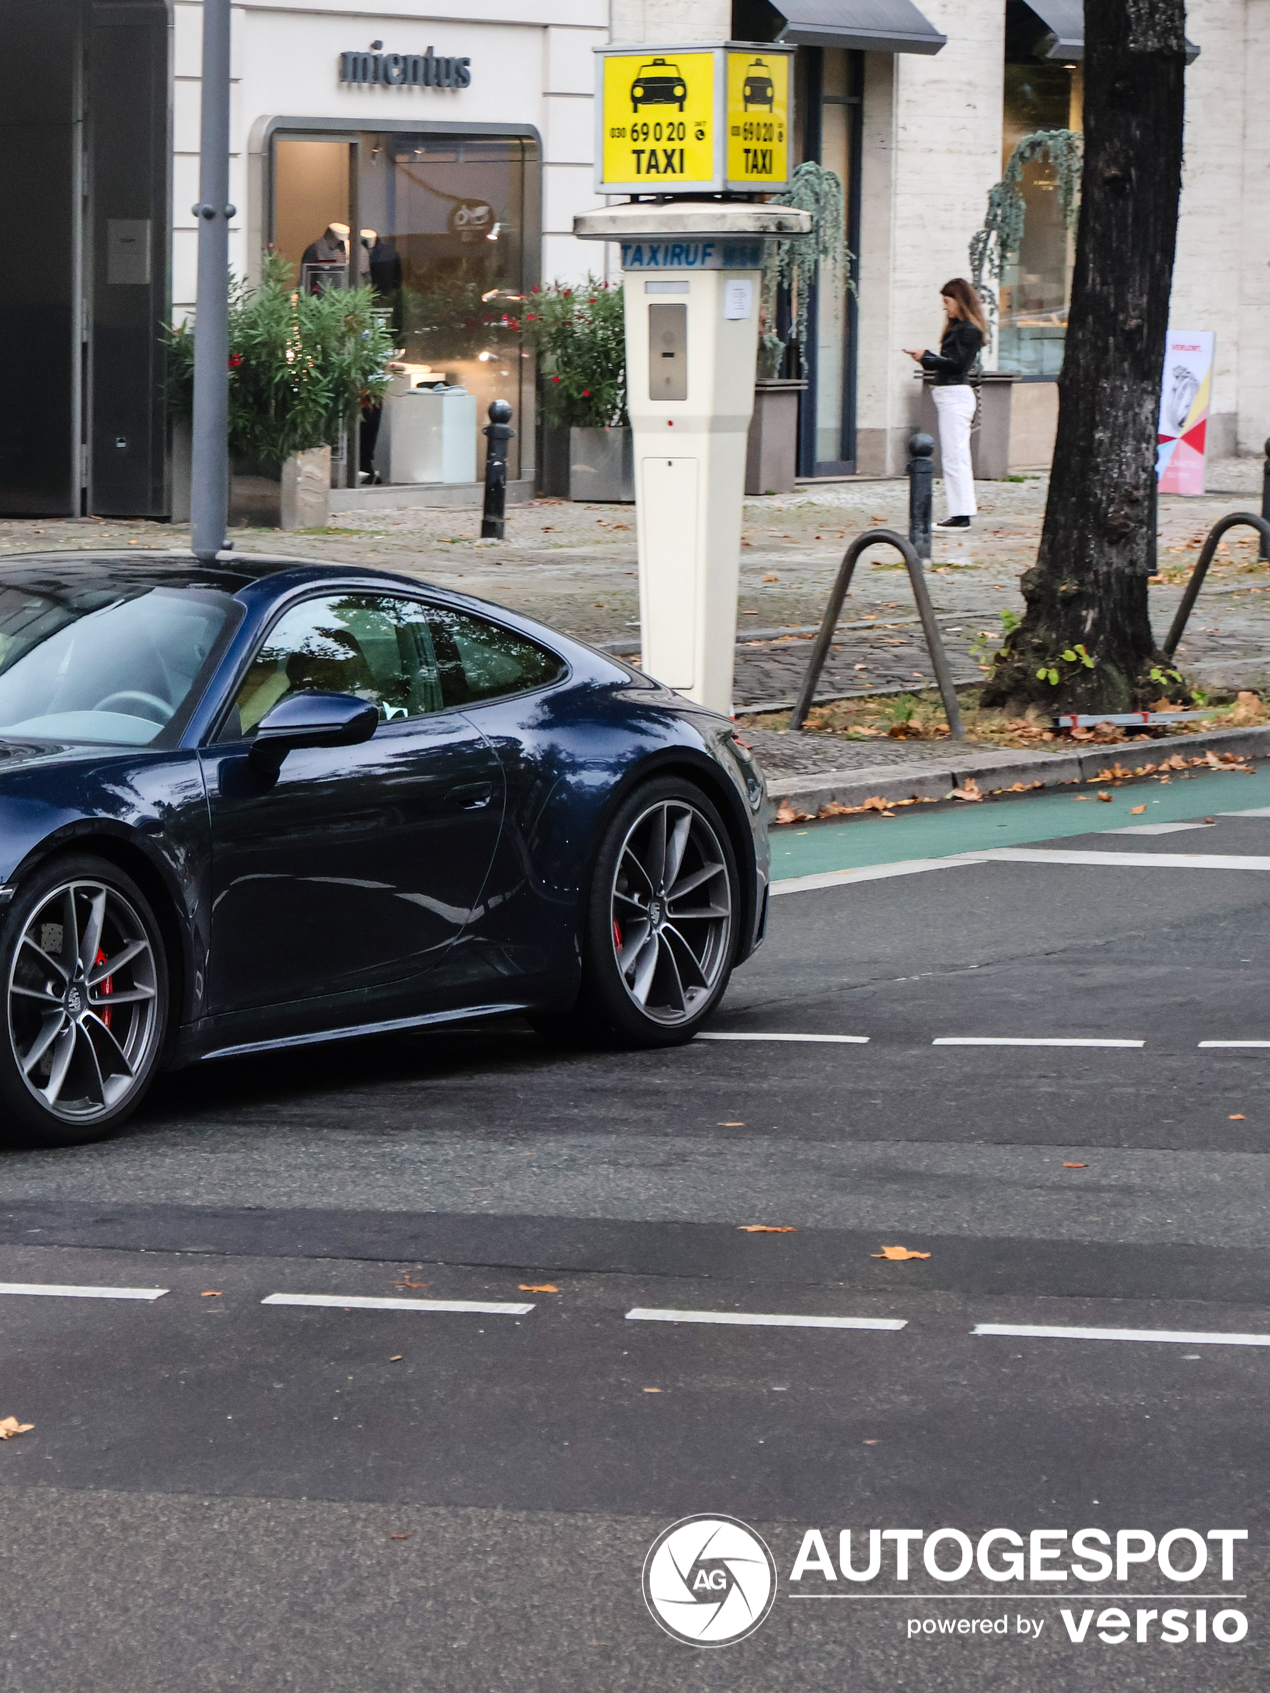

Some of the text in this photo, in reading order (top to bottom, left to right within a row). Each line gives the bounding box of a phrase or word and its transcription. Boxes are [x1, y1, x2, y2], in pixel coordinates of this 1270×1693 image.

[339, 39, 472, 89] mientus
[609, 127, 627, 139] 030
[632, 148, 685, 174] TAXI
[743, 148, 773, 175] TAXI
[621, 242, 716, 267] TAXIRUF
